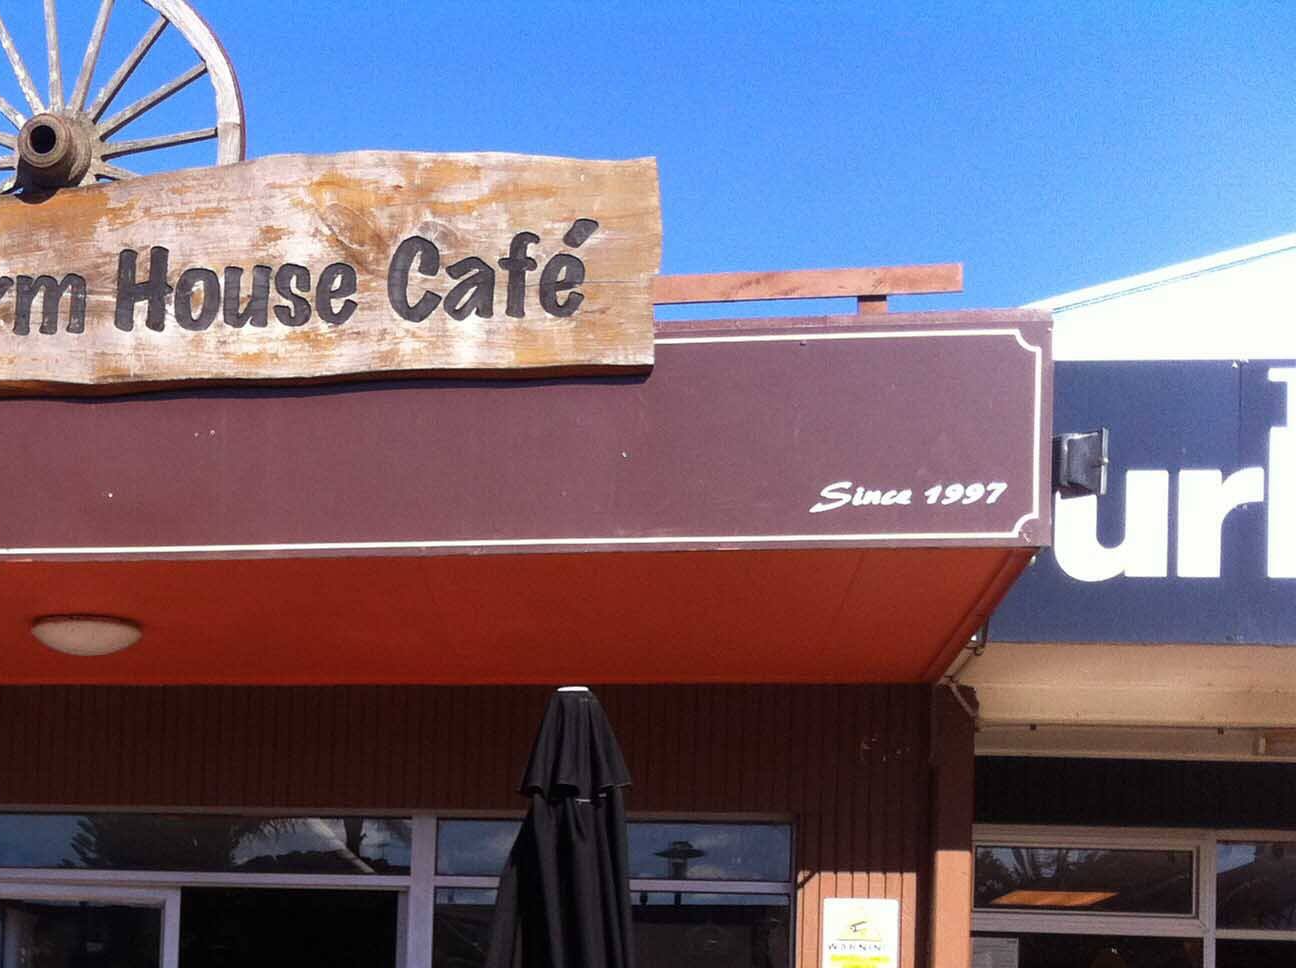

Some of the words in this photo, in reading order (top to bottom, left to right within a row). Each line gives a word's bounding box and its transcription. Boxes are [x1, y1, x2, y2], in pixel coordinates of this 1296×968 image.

[113, 245, 359, 333] House
[387, 218, 599, 323] Café
[809, 481, 913, 513] Since
[924, 482, 1008, 505] 1997
[1054, 367, 1296, 582] ur
